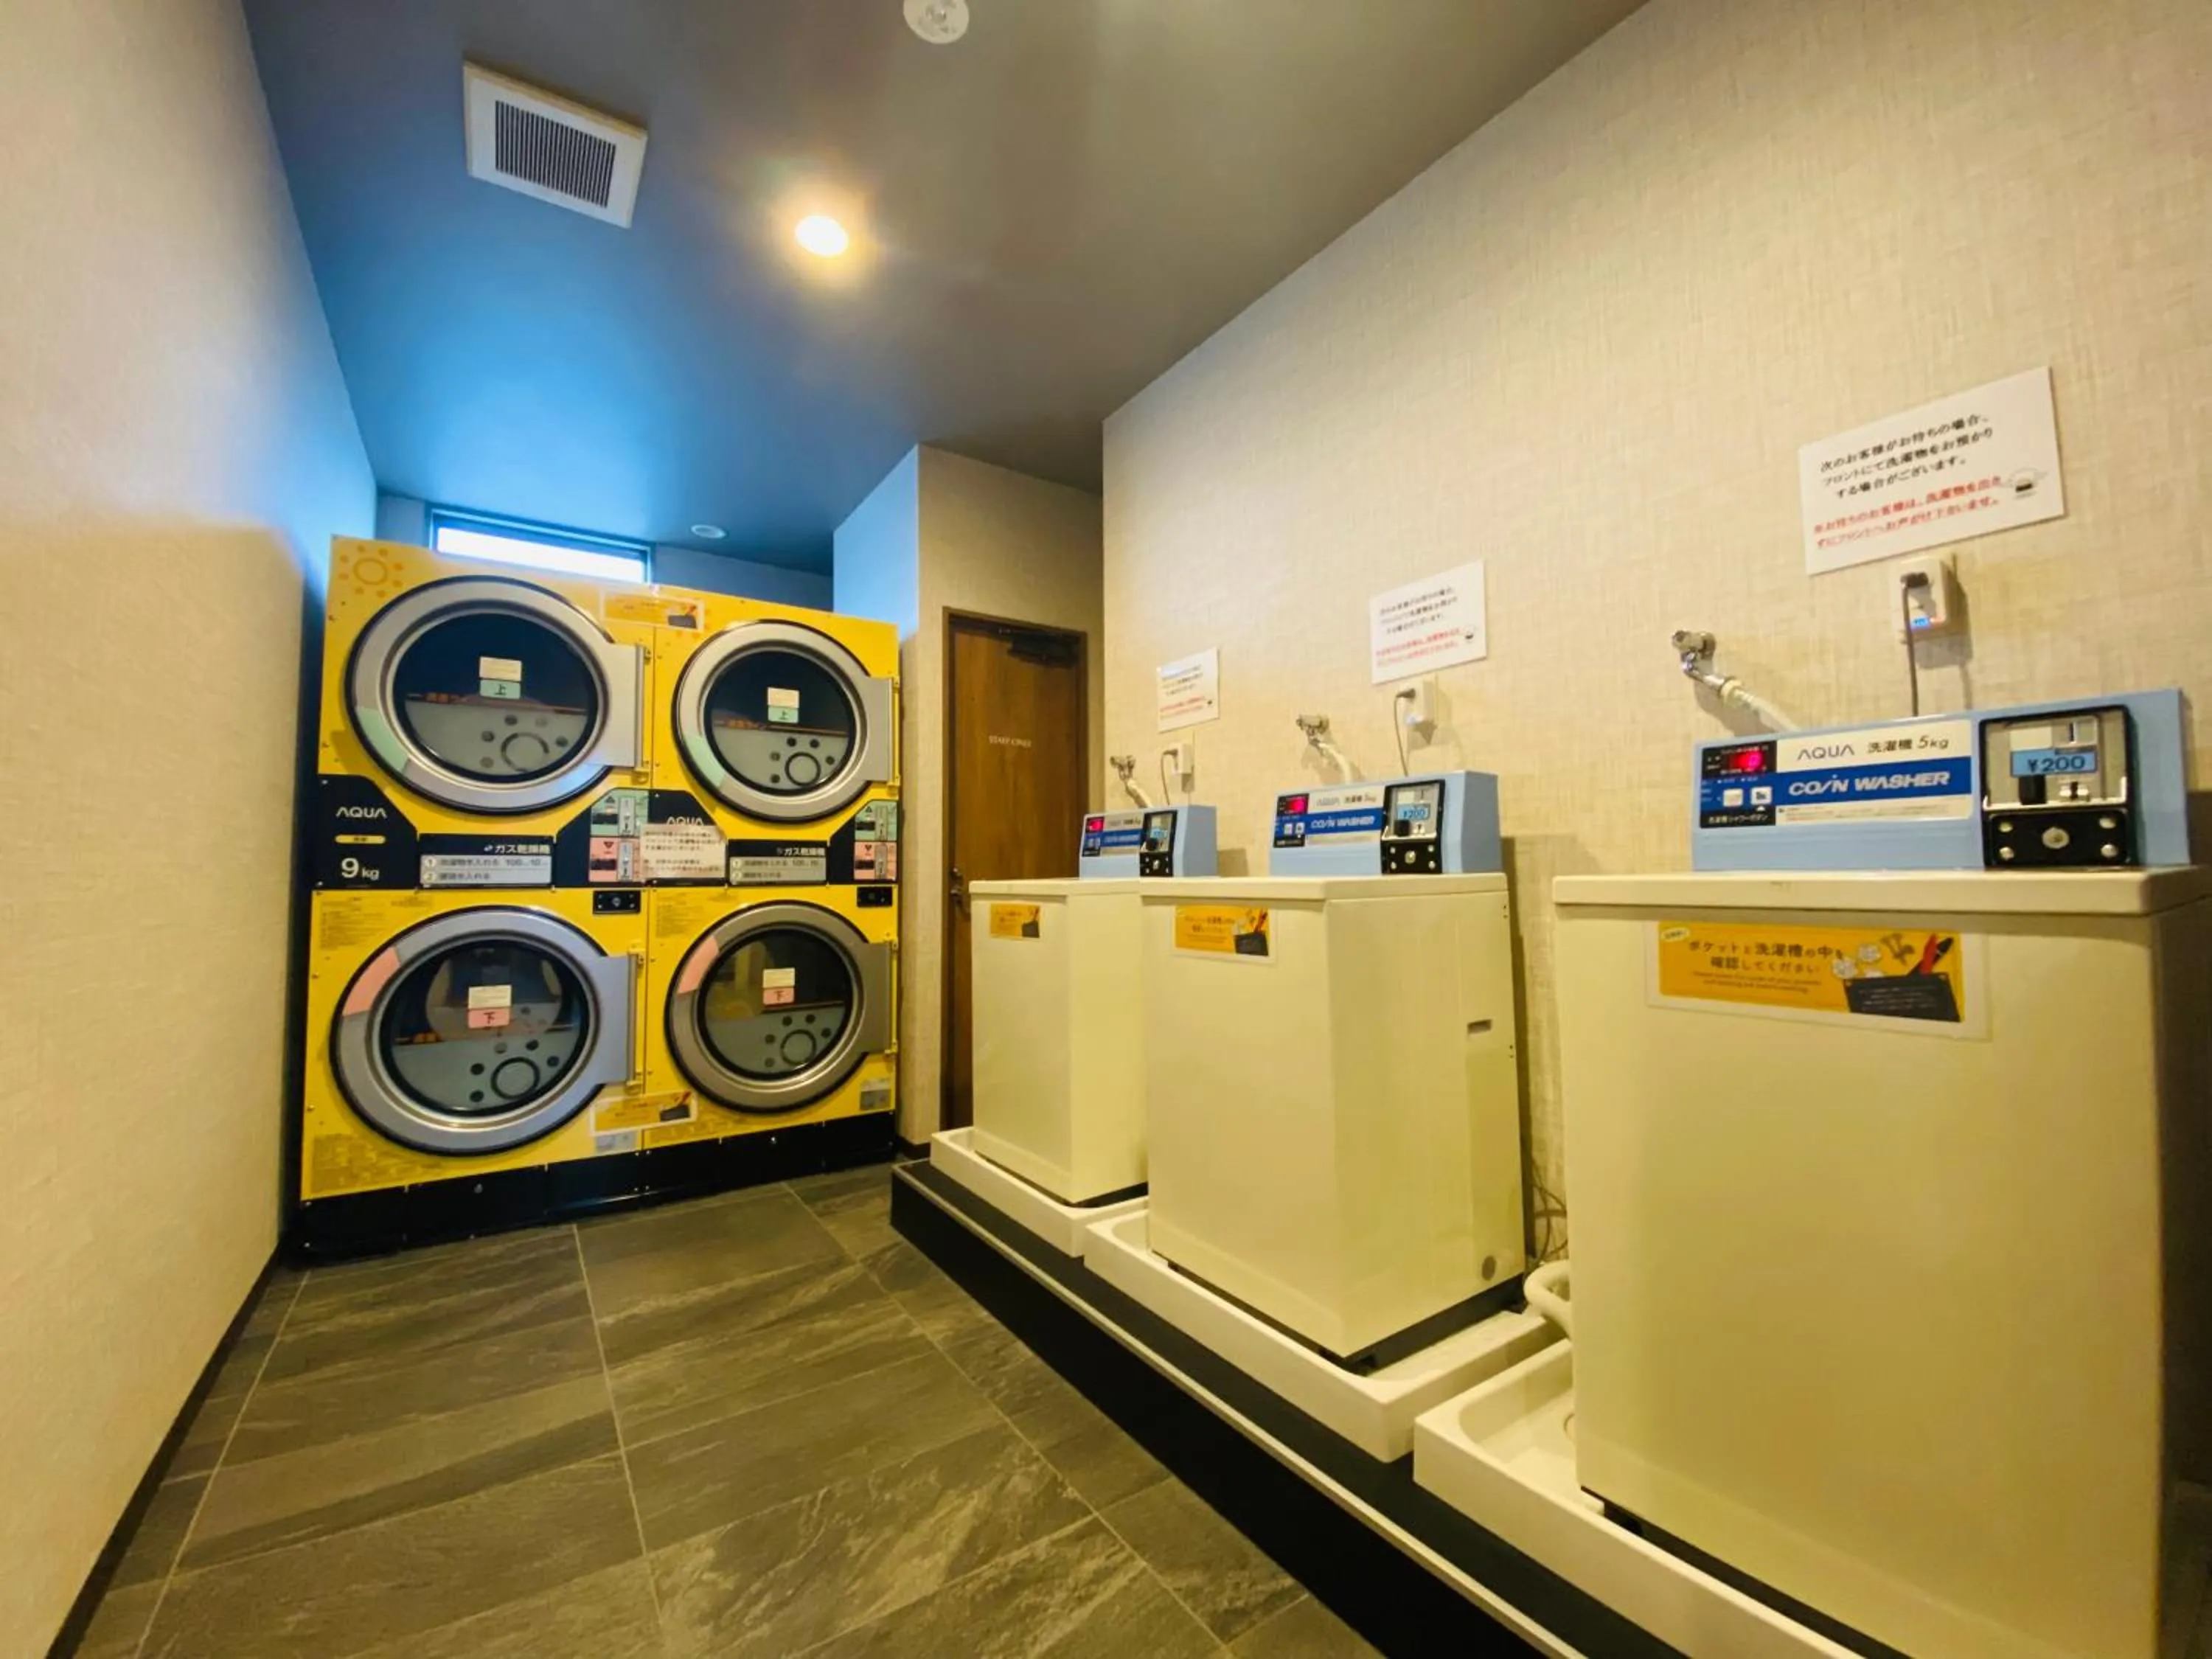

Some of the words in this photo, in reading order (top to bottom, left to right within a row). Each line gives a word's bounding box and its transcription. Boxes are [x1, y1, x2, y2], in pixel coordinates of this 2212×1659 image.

[495, 684, 507, 696] 上
[1798, 744, 1855, 761] AQUA
[1867, 739, 1913, 754] 洗濯機
[2028, 755, 2086, 773] ¥200
[1854, 771, 1951, 792] WASHER
[335, 806, 387, 818] AQUA
[483, 1011, 495, 1024] 下
